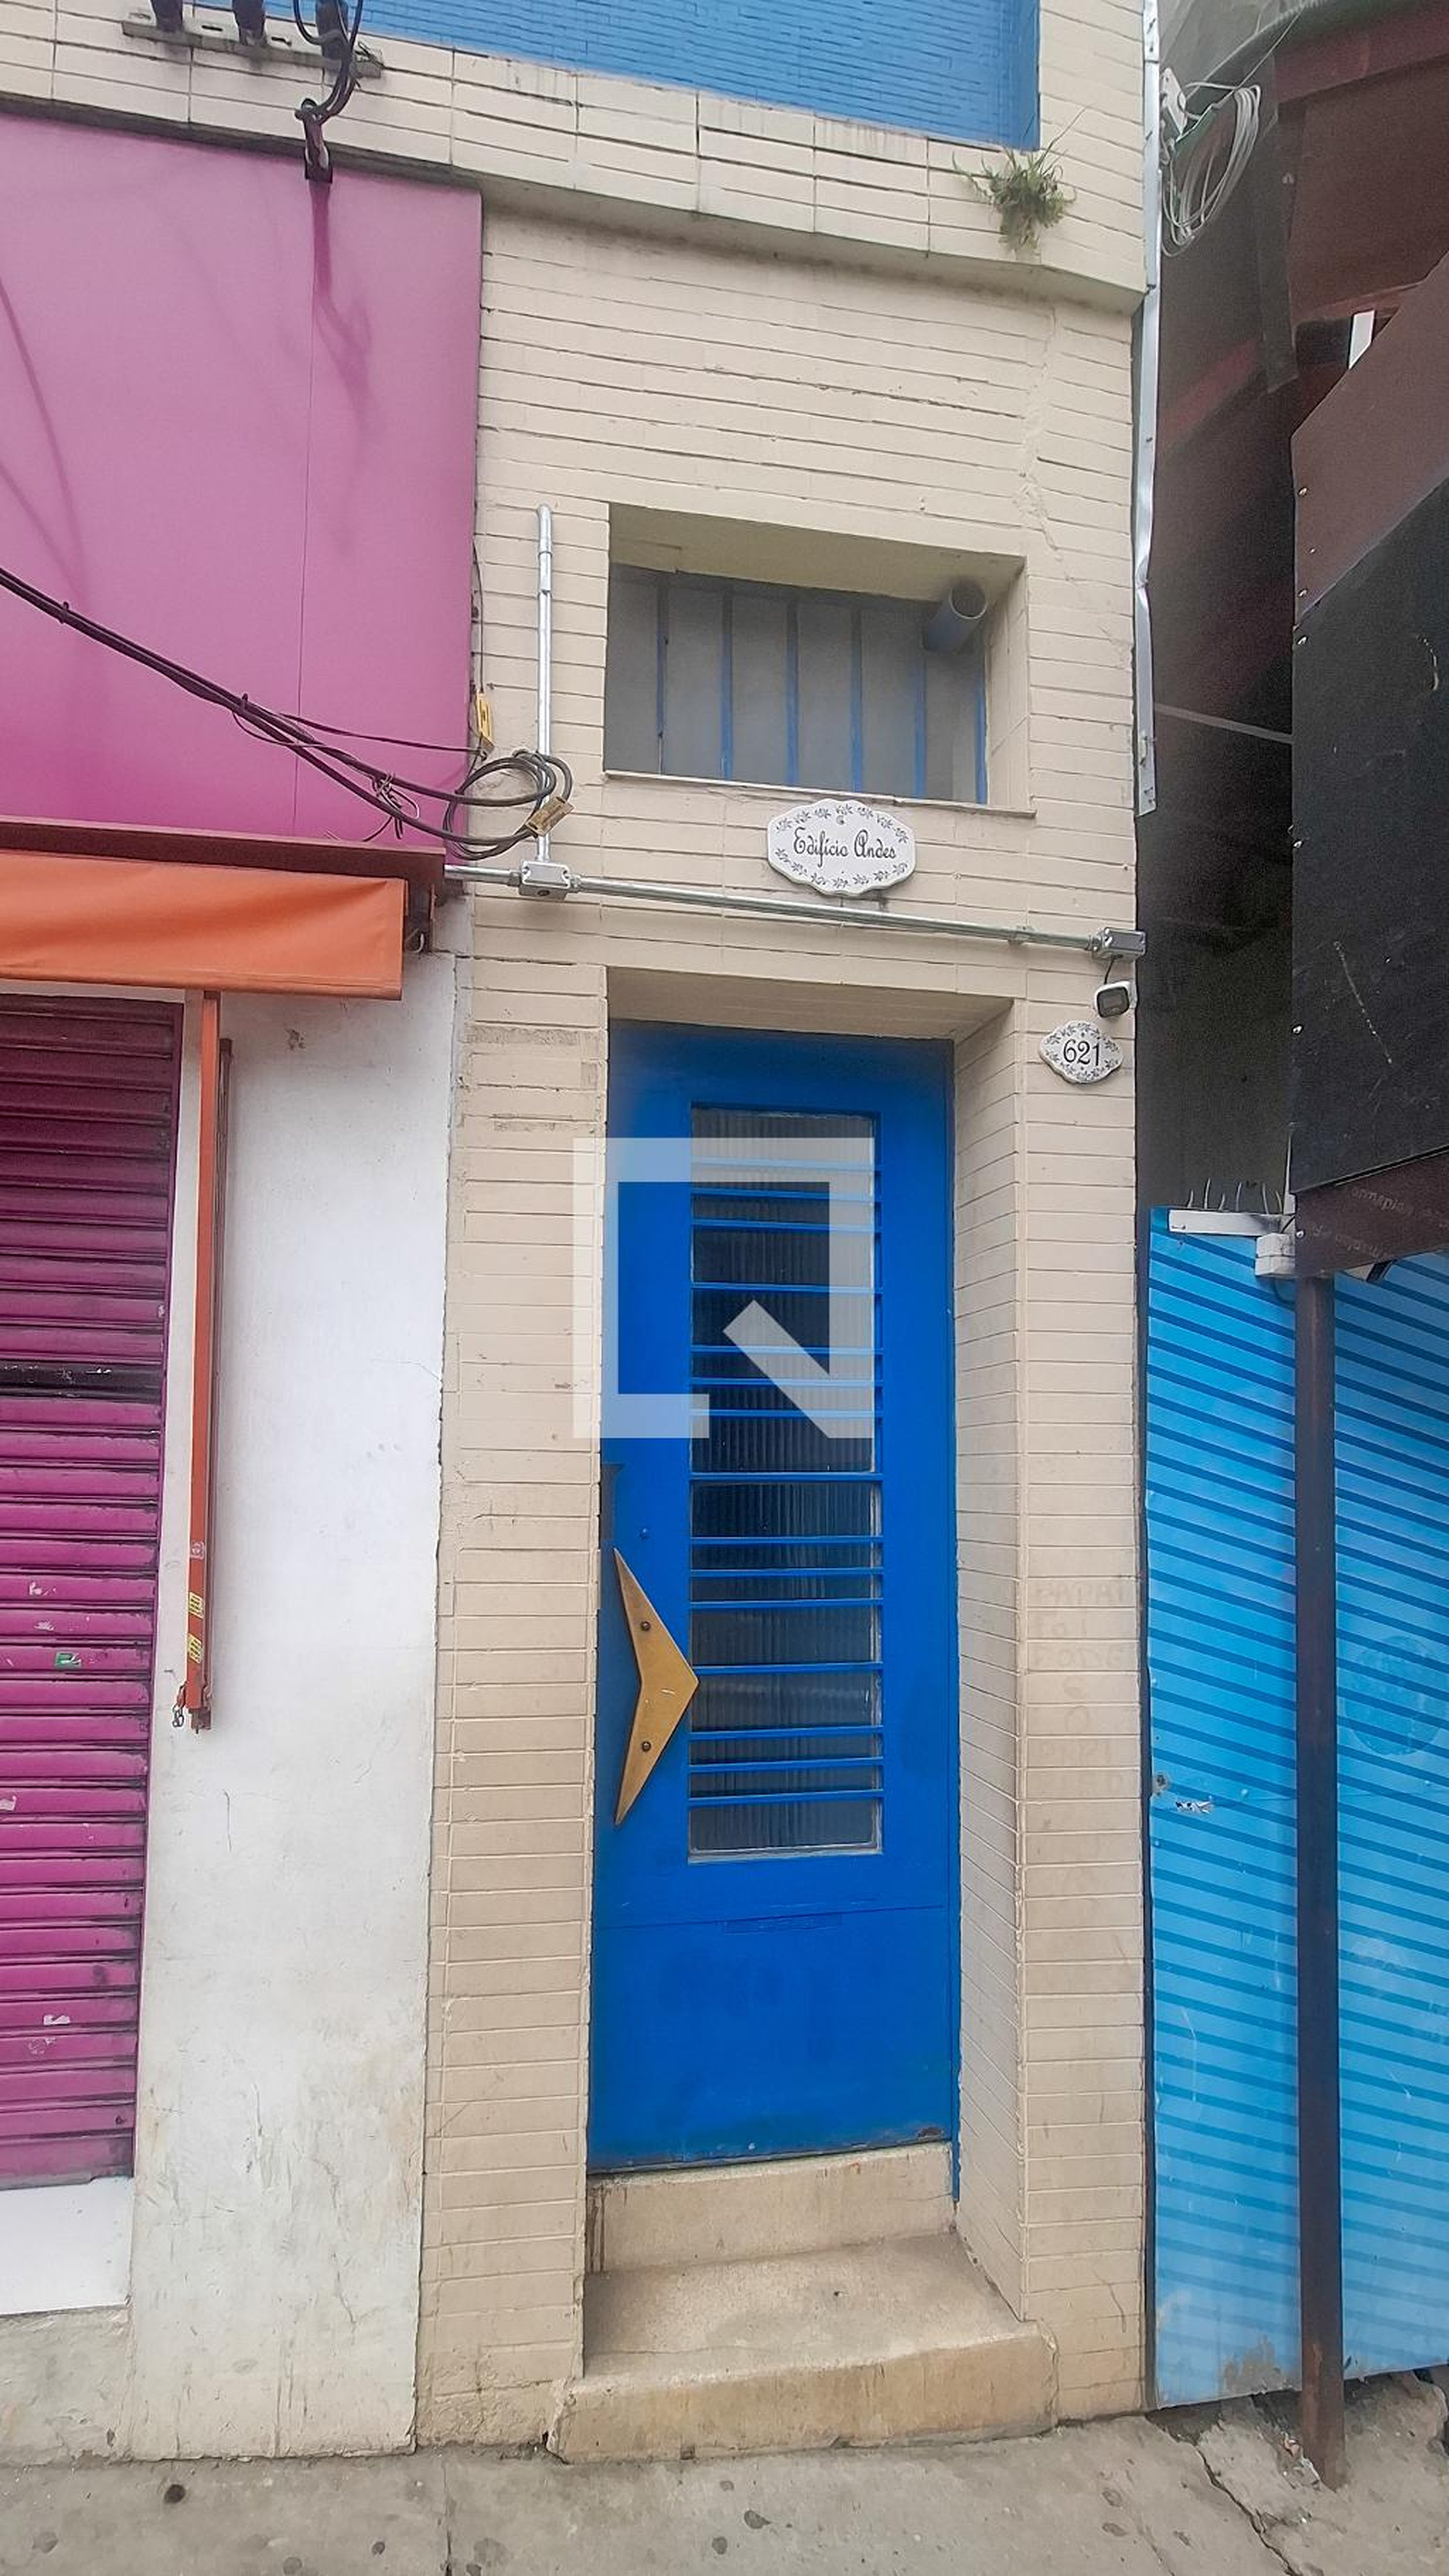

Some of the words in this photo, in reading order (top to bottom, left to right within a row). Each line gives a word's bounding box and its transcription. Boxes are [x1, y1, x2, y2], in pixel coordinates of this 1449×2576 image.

[794, 826, 849, 868] Edifício
[854, 829, 897, 859] Andes
[1063, 1039, 1100, 1066] 621
